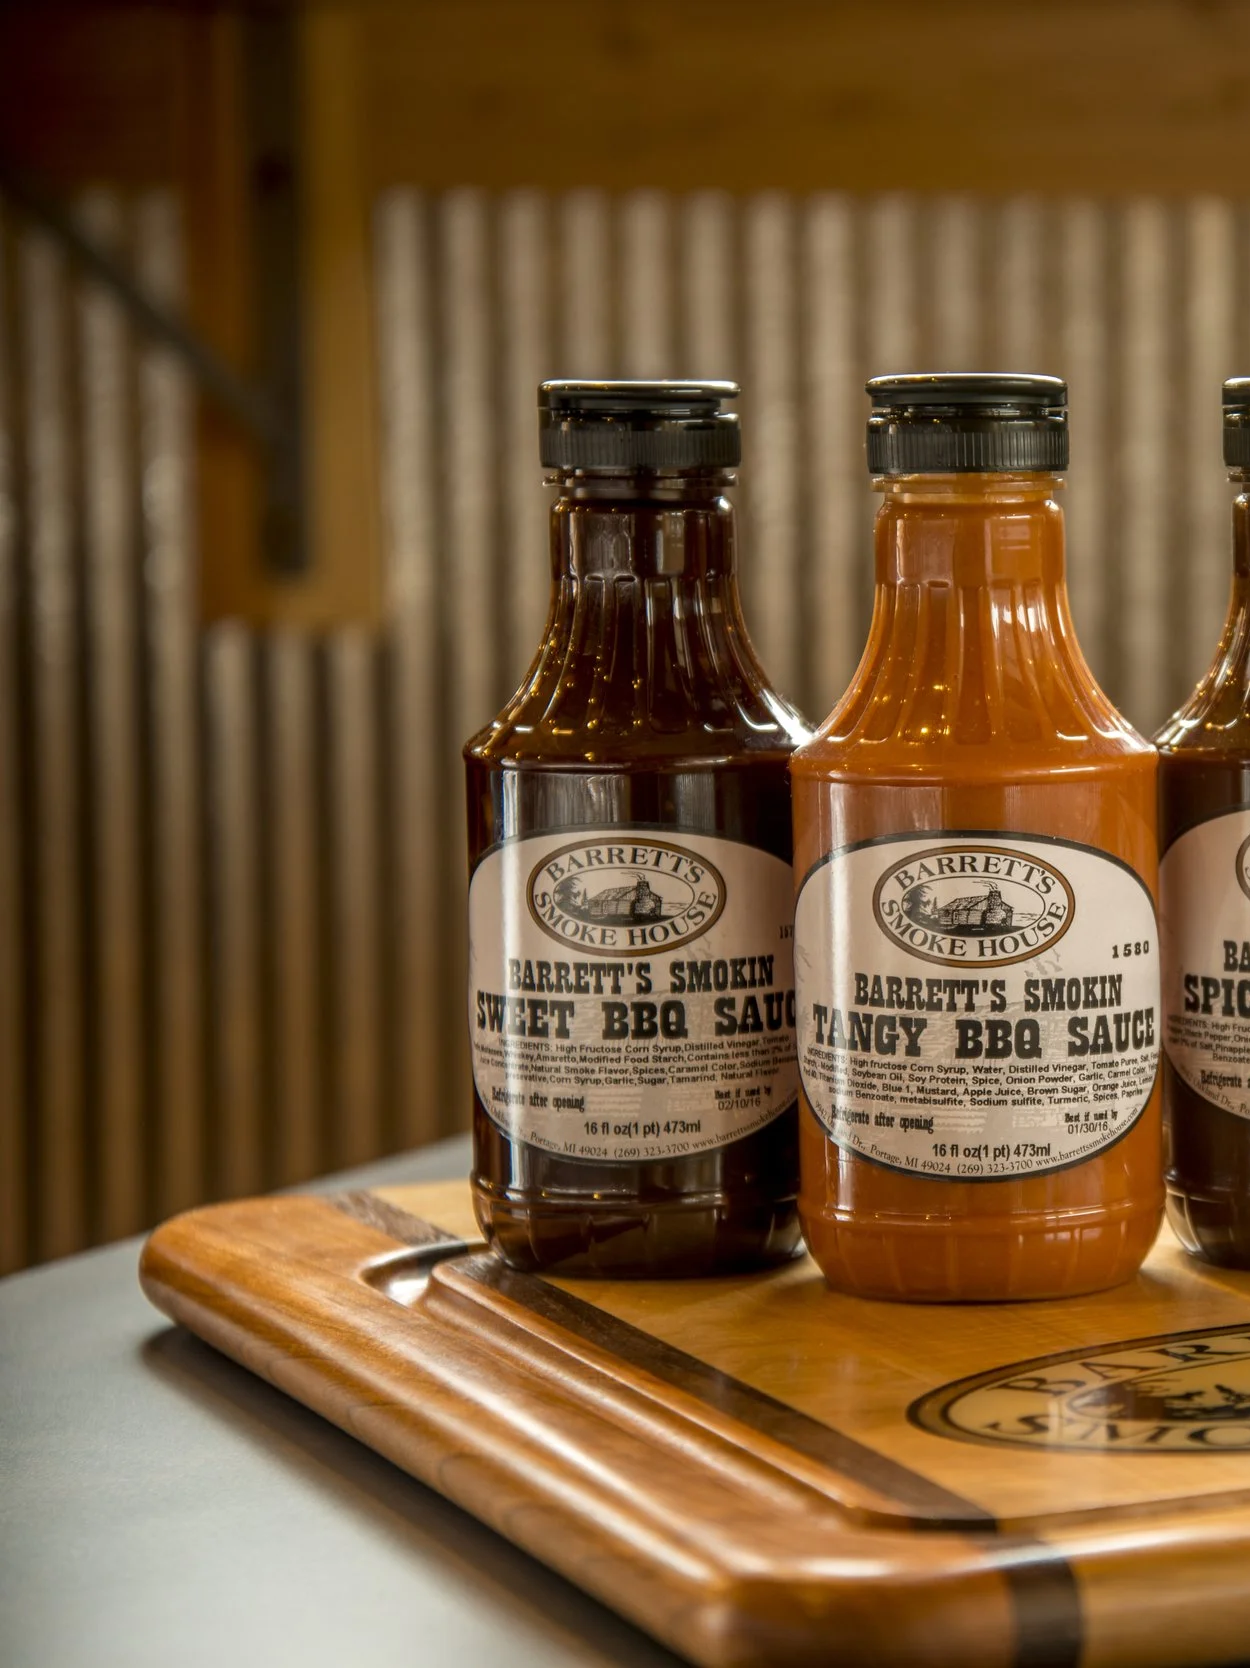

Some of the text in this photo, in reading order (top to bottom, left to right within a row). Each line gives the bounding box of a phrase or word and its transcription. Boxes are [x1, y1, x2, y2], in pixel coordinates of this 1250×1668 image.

[544, 847, 704, 886] BARRETT'S
[893, 855, 1056, 895] BARRETT'S
[534, 891, 717, 946] SMOKE HOUSE
[881, 900, 1067, 957] SMOKE HOUSE
[1112, 940, 1149, 959] 1580
[509, 954, 774, 995] BARRETT'S SMOKIN
[854, 972, 1122, 1013] BARRETT'S SMOKIN
[477, 988, 797, 1040] SWEET BBQ SAUC
[813, 1003, 1154, 1059] TANGY BBQ SAUCE
[1211, 1020, 1230, 1031] High
[556, 1044, 577, 1055] High
[579, 1045, 622, 1054] Fructose
[625, 1045, 649, 1053] Corn
[624, 1055, 649, 1064] Food
[732, 1049, 749, 1060] less
[752, 1047, 770, 1057] than
[1212, 1053, 1250, 1063] Benzoate
[565, 1066, 595, 1075] Smoke
[721, 1067, 779, 1080] Natural Flavor
[850, 1056, 868, 1068] High
[870, 1059, 907, 1071] fructose
[910, 1064, 934, 1073] Corn
[936, 1065, 969, 1075] Syrup,
[972, 1065, 1006, 1076] Water,
[1009, 1063, 1049, 1074] Distilled
[1052, 1063, 1089, 1074] Vinegar,
[1092, 1060, 1119, 1070] Tomato
[852, 1067, 887, 1082] Soybean
[889, 1072, 905, 1083] Oil,
[908, 1075, 926, 1085] Soy
[929, 1075, 968, 1086] Protein,
[972, 1076, 1003, 1087] Spice,
[1006, 1076, 1036, 1085] Onion
[1038, 1074, 1076, 1084] Powder,
[1079, 1072, 1105, 1082] Garlic,
[1107, 1069, 1131, 1079] Carmel
[1200, 1069, 1242, 1090] Refrigerate
[848, 1079, 879, 1092] Dioxide,
[882, 1083, 903, 1093] Blue
[917, 1085, 960, 1097] Mustard,
[962, 1088, 992, 1098] Apple
[994, 1088, 1024, 1097] Juice,
[1027, 1086, 1058, 1095] Brown
[1061, 1085, 1090, 1096] Sugar,
[1092, 1081, 1119, 1092] Orange
[1120, 1078, 1138, 1089] Juice,
[856, 1089, 897, 1104] Benzoate,
[899, 1096, 967, 1107] metabisulfite,
[970, 1098, 1007, 1107] Sodium
[1011, 1097, 1044, 1107] sulfite,
[1048, 1094, 1091, 1105] Turmeric,
[1093, 1091, 1119, 1102] Spices,
[529, 1092, 548, 1107] after
[552, 1095, 585, 1113] opening
[718, 1097, 761, 1111] 02/10/16
[875, 1112, 895, 1128] after
[900, 1115, 934, 1134] opening
[1064, 1108, 1118, 1123] Best if used by
[584, 1121, 598, 1135] 16
[601, 1121, 609, 1135] fl
[643, 1121, 660, 1138] pt)
[663, 1120, 701, 1135] 473ml
[1067, 1121, 1108, 1135] 01/30/16
[563, 1141, 576, 1153] MI
[579, 1144, 608, 1156] 49024
[614, 1147, 640, 1159] (269)
[643, 1142, 690, 1156] 323-3700
[870, 1144, 902, 1164] Portage,
[905, 1156, 918, 1168] MI
[921, 1161, 950, 1173] 49024
[957, 1164, 984, 1175] (269)
[987, 1160, 1033, 1174] 323-3700
[1036, 1107, 1138, 1167] www.barrettssmokehouse.com
[932, 1143, 946, 1157] 16
[950, 1143, 958, 1157] fl
[993, 1144, 1010, 1161] pt)
[1013, 1143, 1051, 1158] 473ml
